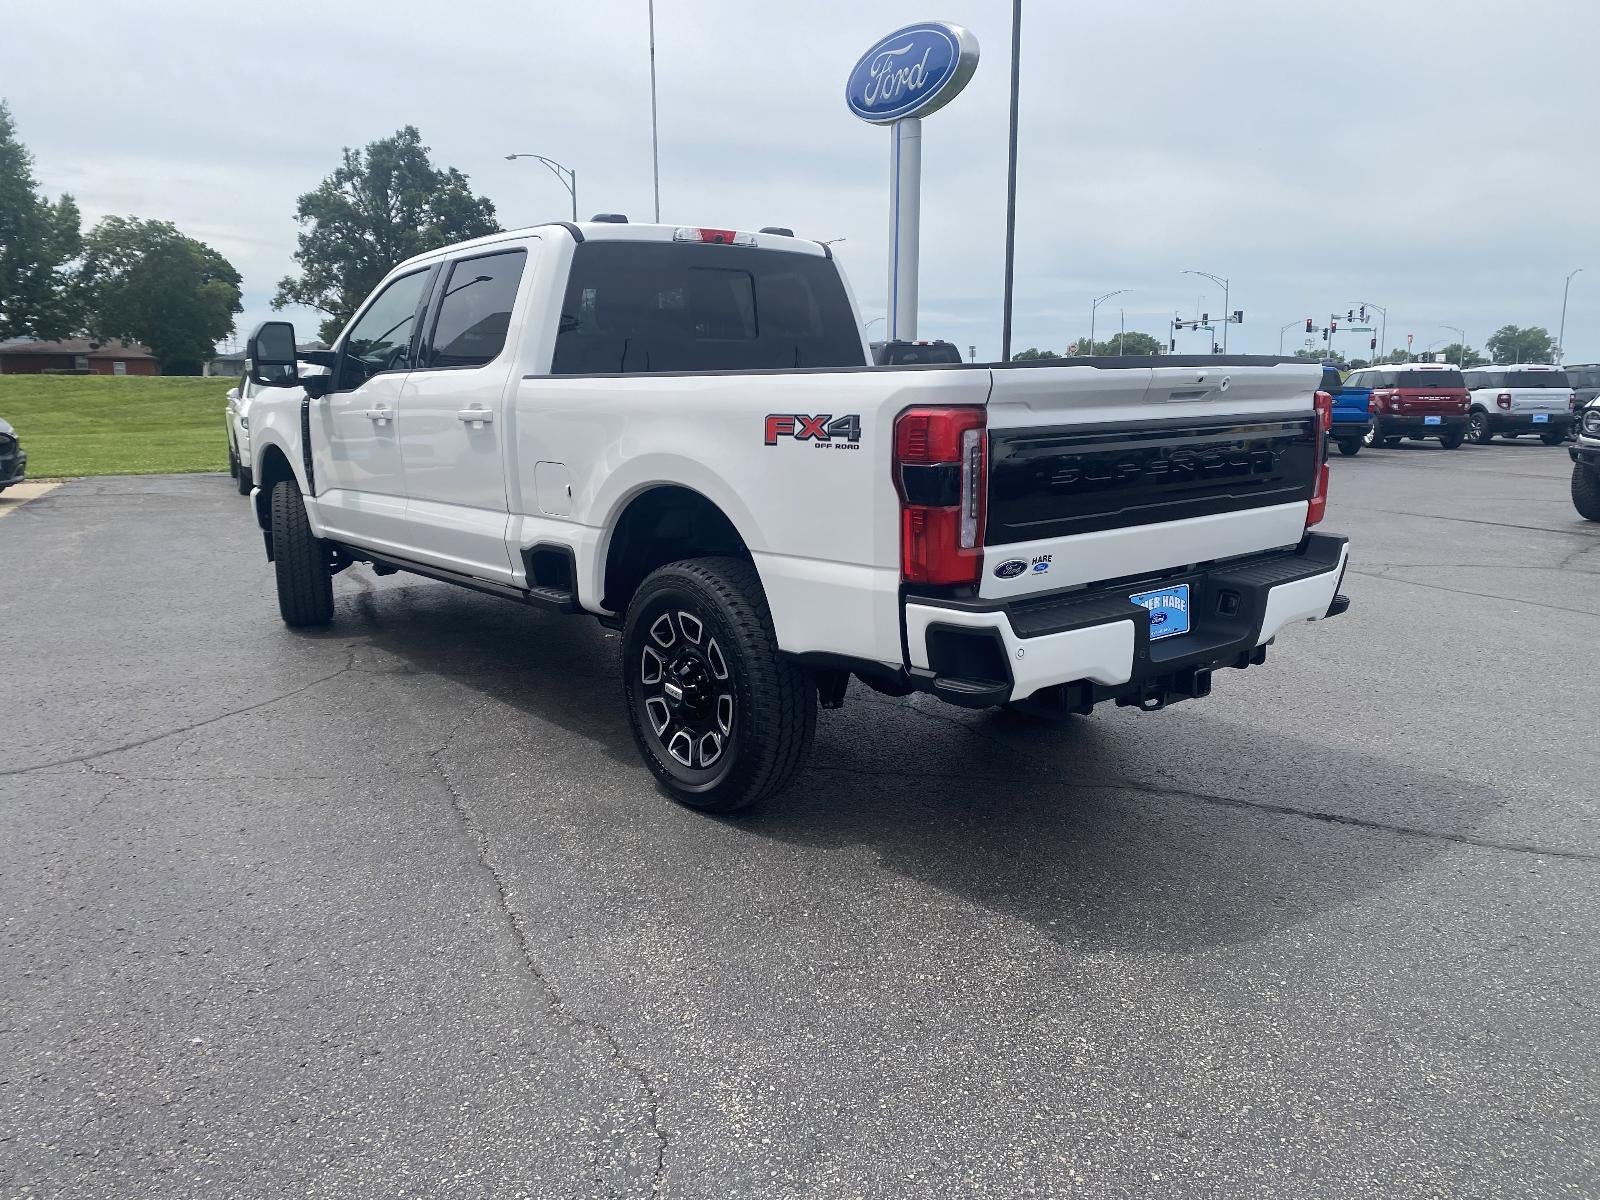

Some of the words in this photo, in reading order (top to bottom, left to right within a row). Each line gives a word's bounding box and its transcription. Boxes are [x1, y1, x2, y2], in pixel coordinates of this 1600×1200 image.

[864, 42, 931, 106] Ford
[764, 413, 861, 446] FX4
[1032, 555, 1053, 566] HARE
[1162, 595, 1186, 613] HARE
